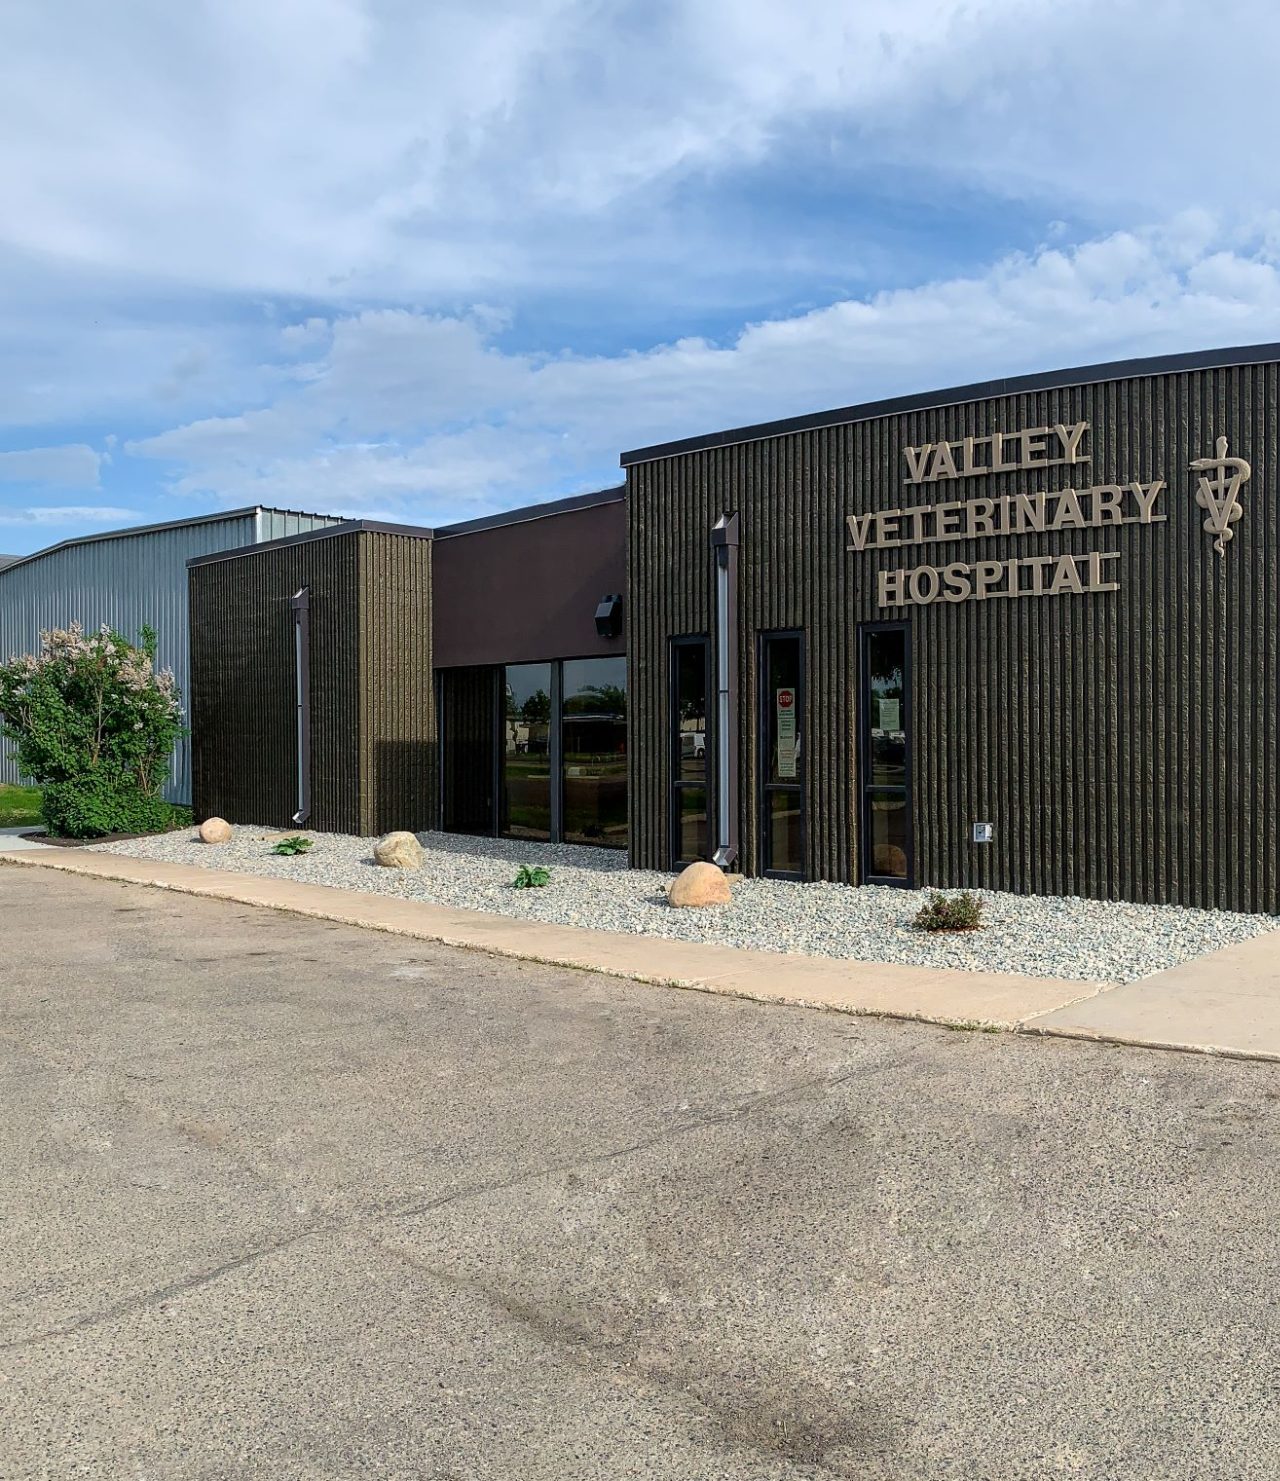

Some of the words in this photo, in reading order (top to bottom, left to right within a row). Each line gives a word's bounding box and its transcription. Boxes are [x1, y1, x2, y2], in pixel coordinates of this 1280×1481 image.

[904, 421, 1089, 484] VALLEY
[846, 480, 1166, 551] VETERINARY
[878, 551, 1120, 607] HOSPITAL
